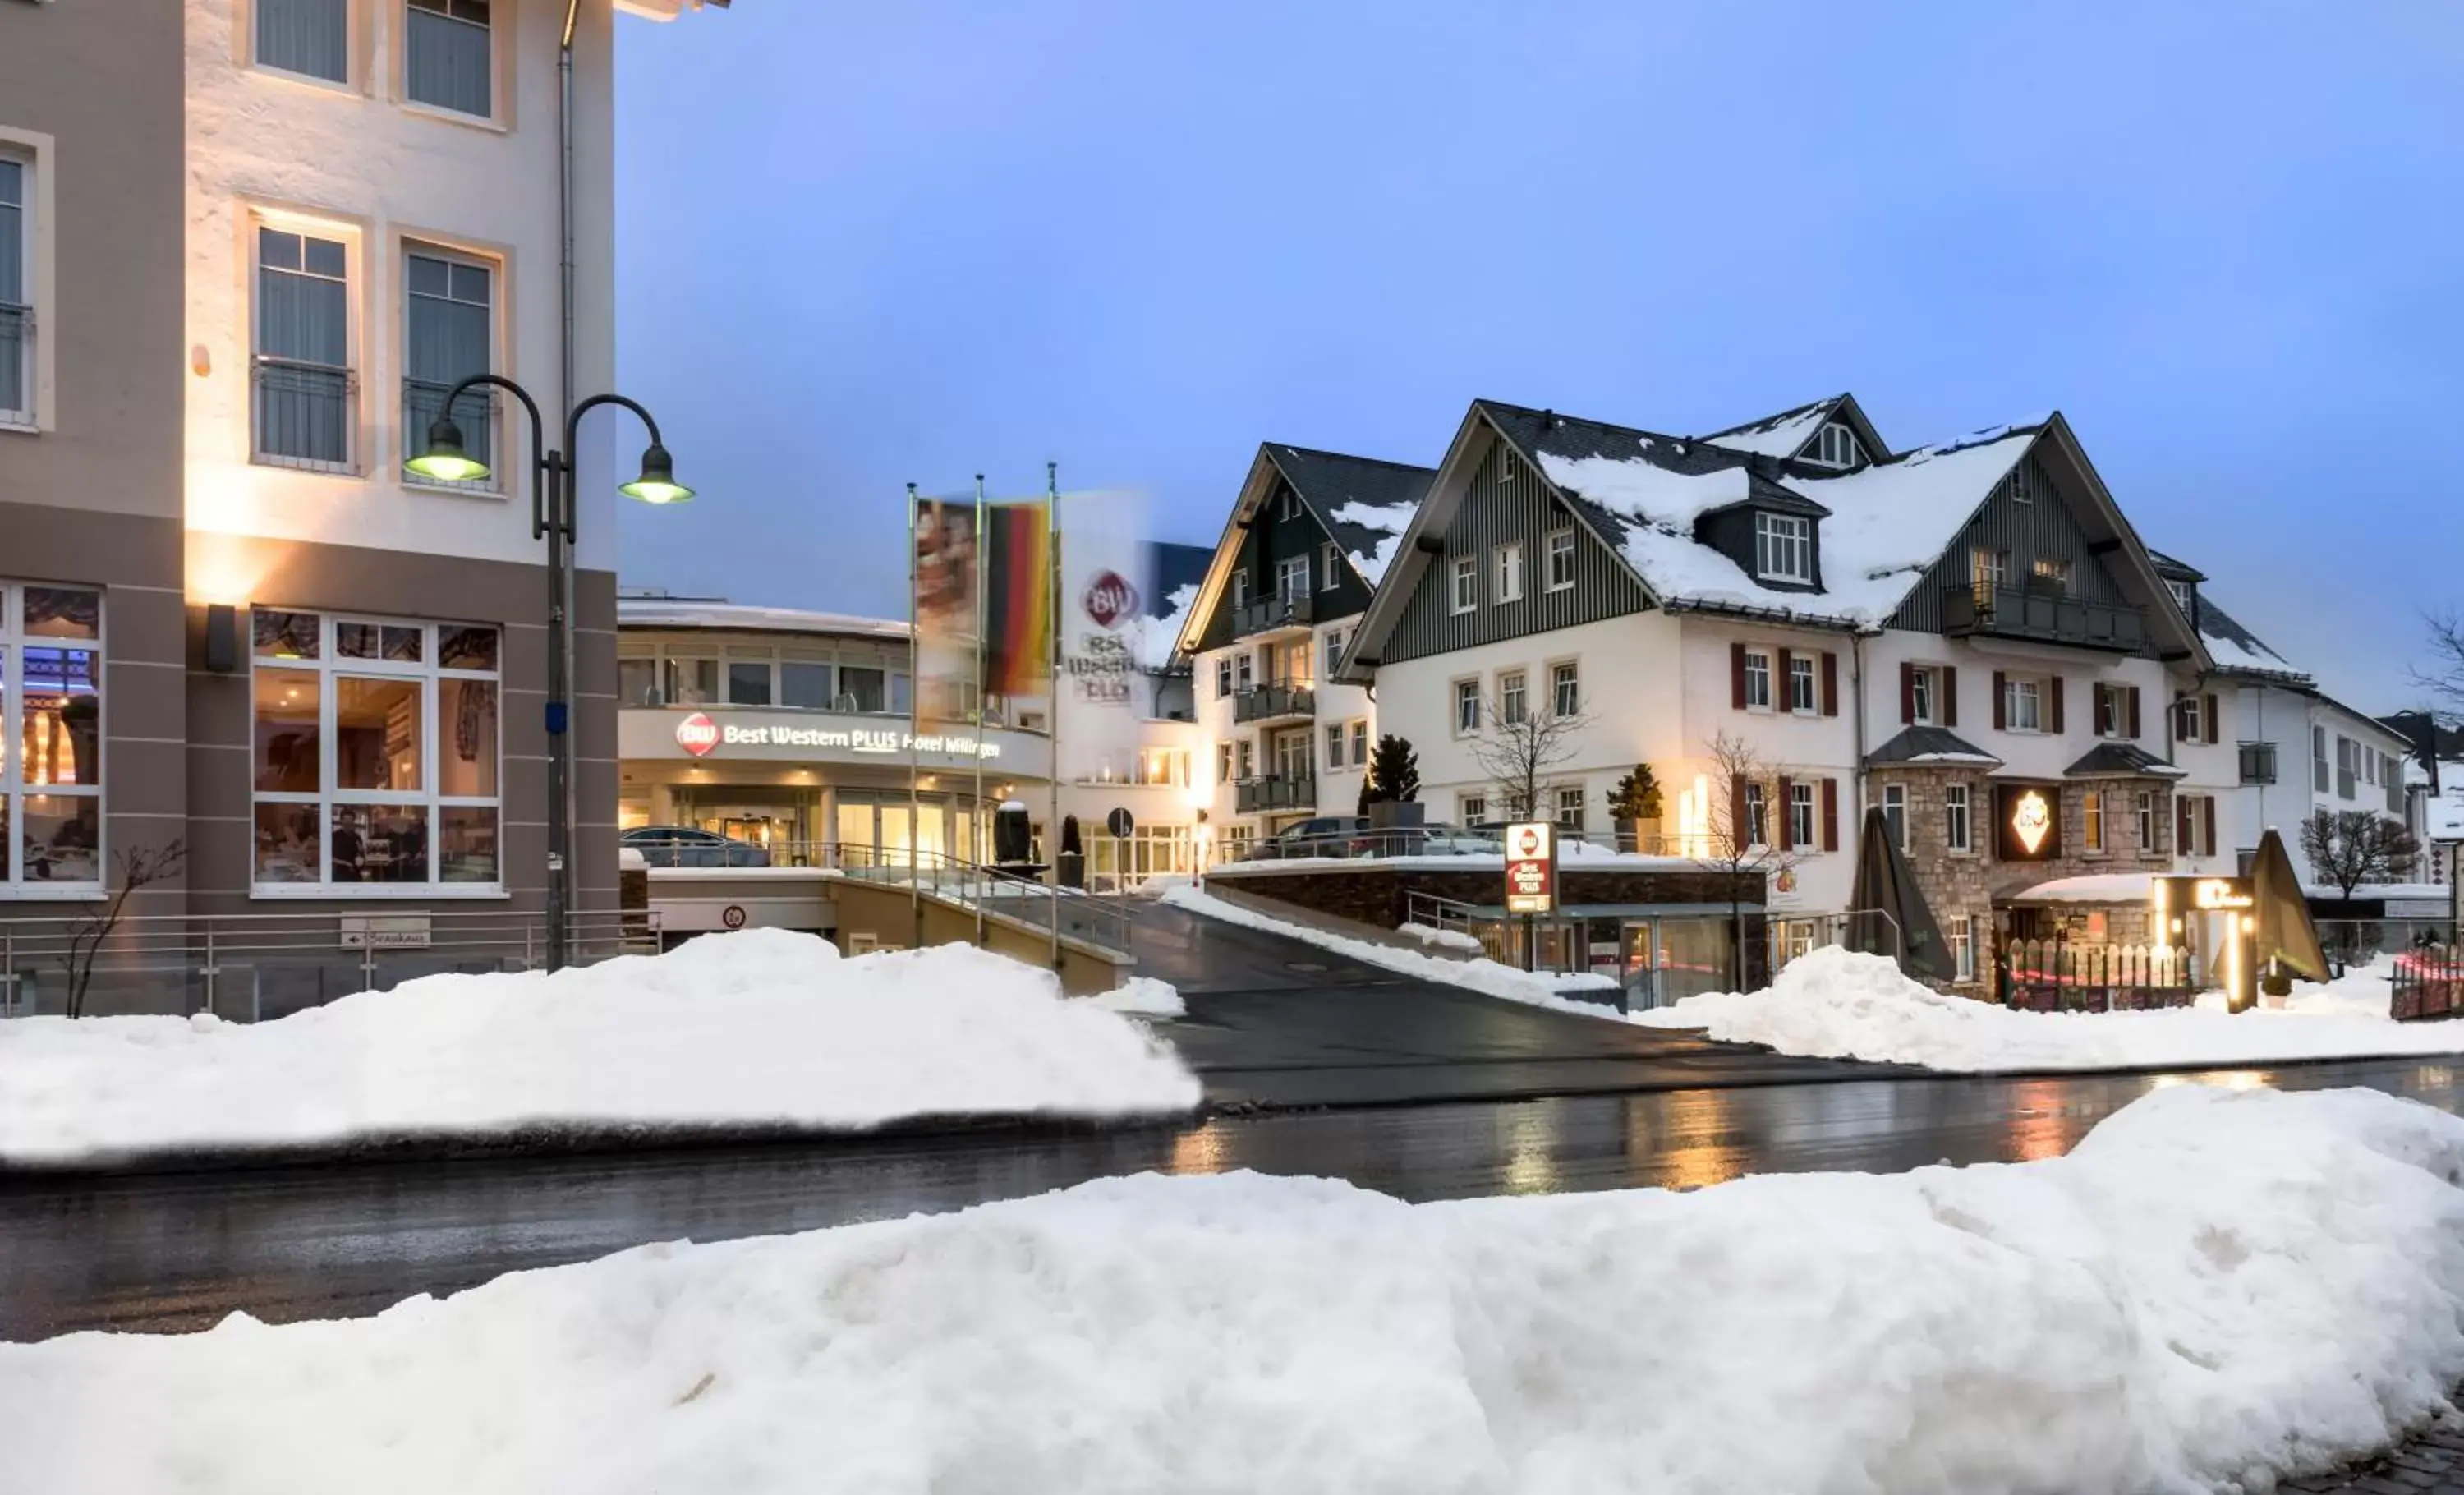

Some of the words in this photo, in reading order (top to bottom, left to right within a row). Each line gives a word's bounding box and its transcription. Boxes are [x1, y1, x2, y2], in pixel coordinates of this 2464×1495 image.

[724, 725, 768, 744] Best
[770, 726, 848, 747] Western
[852, 729, 897, 749] PLUS
[902, 734, 943, 752] Hotel
